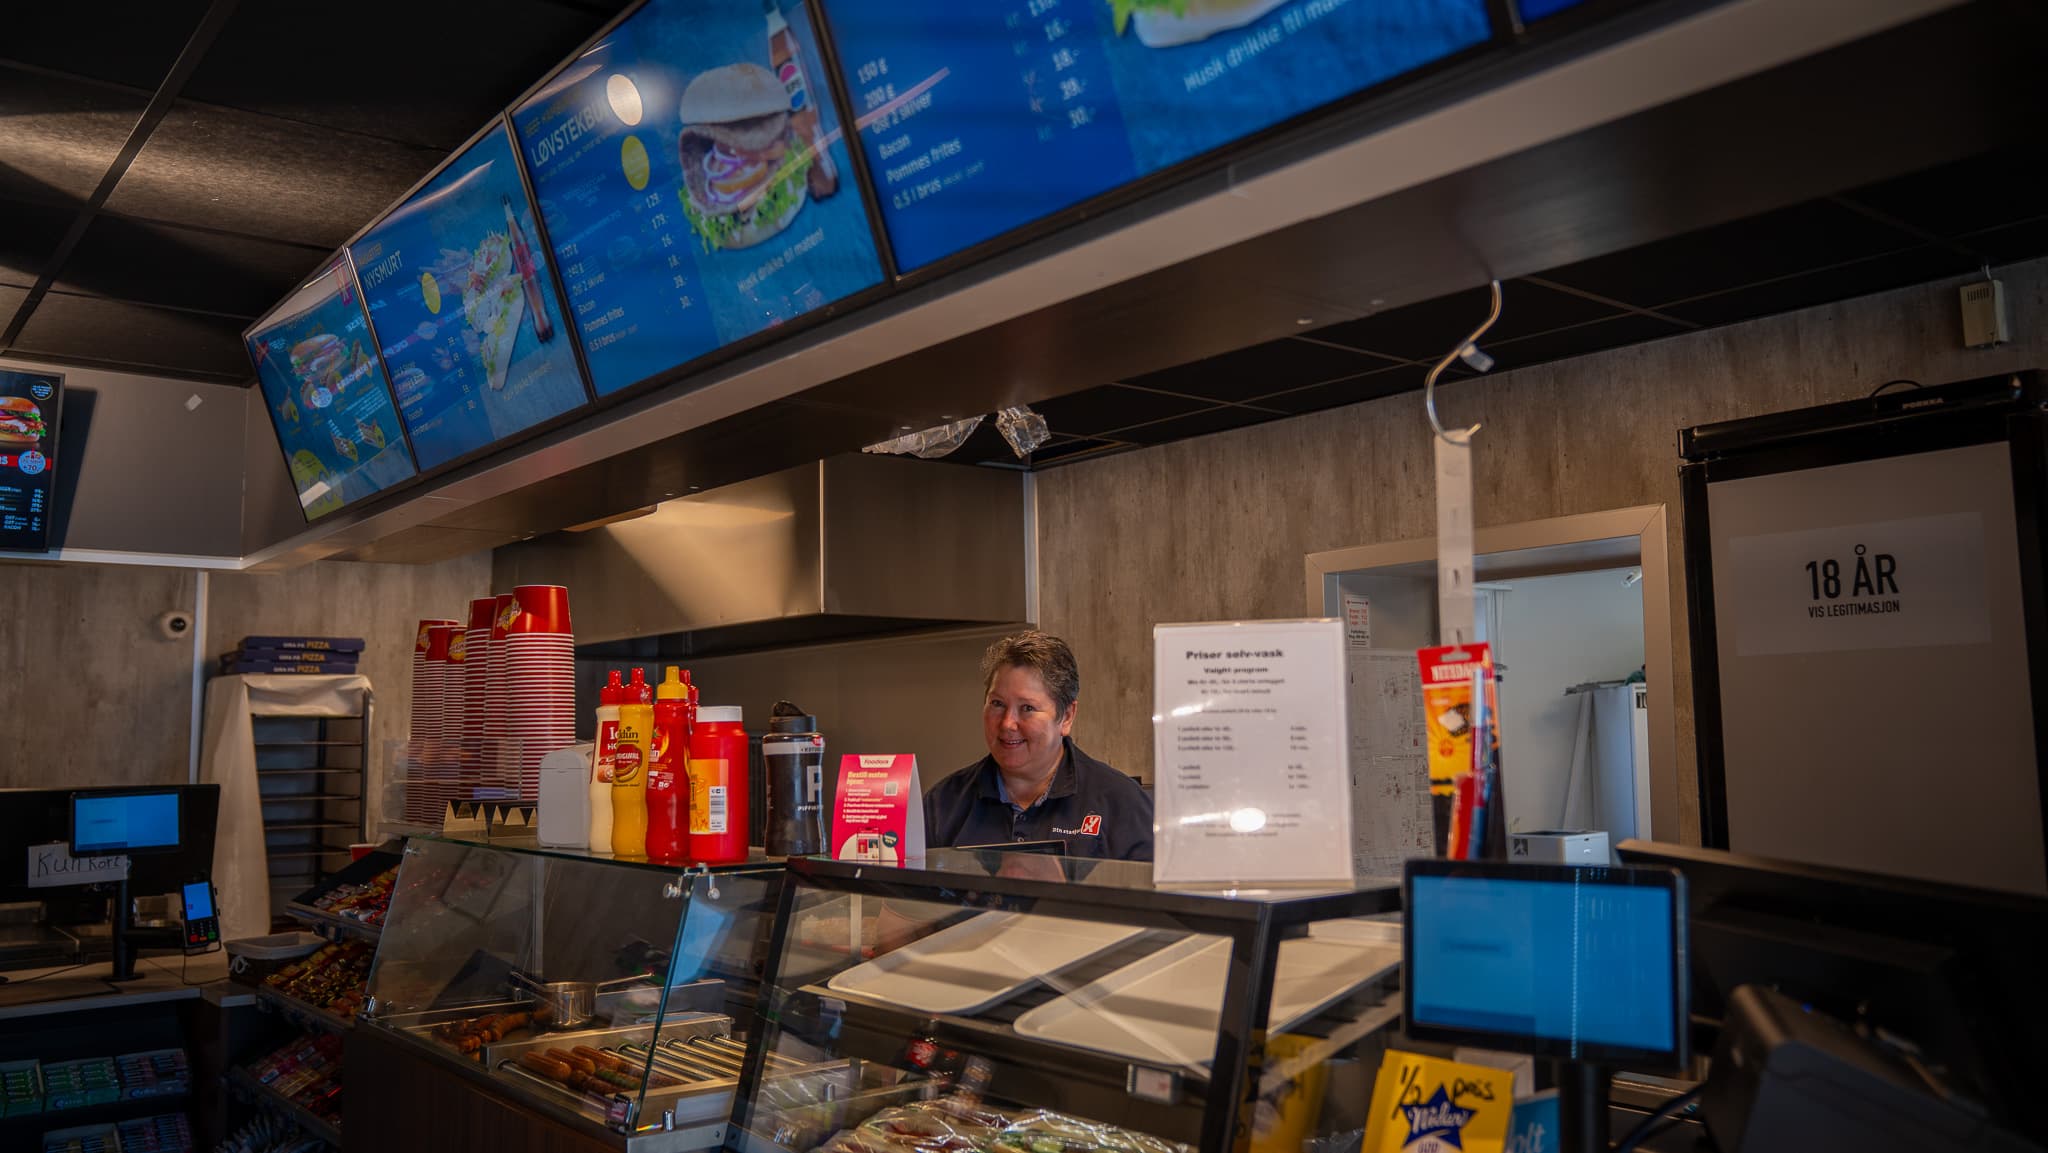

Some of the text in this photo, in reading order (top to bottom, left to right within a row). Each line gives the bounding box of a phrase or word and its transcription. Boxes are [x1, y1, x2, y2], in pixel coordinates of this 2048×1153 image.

[878, 134, 911, 160] Bacon
[885, 138, 962, 184] Pommes frites
[363, 249, 403, 290] NYSMURT
[1805, 543, 1900, 601] 18 ÅR
[1808, 599, 1900, 619] VIS LEGITIMASJON
[305, 640, 330, 649] PIZZA
[1185, 650, 1221, 660] Priser
[302, 652, 326, 662] PIZZA
[297, 665, 320, 673] PIZZA
[37, 852, 80, 878] Kun
